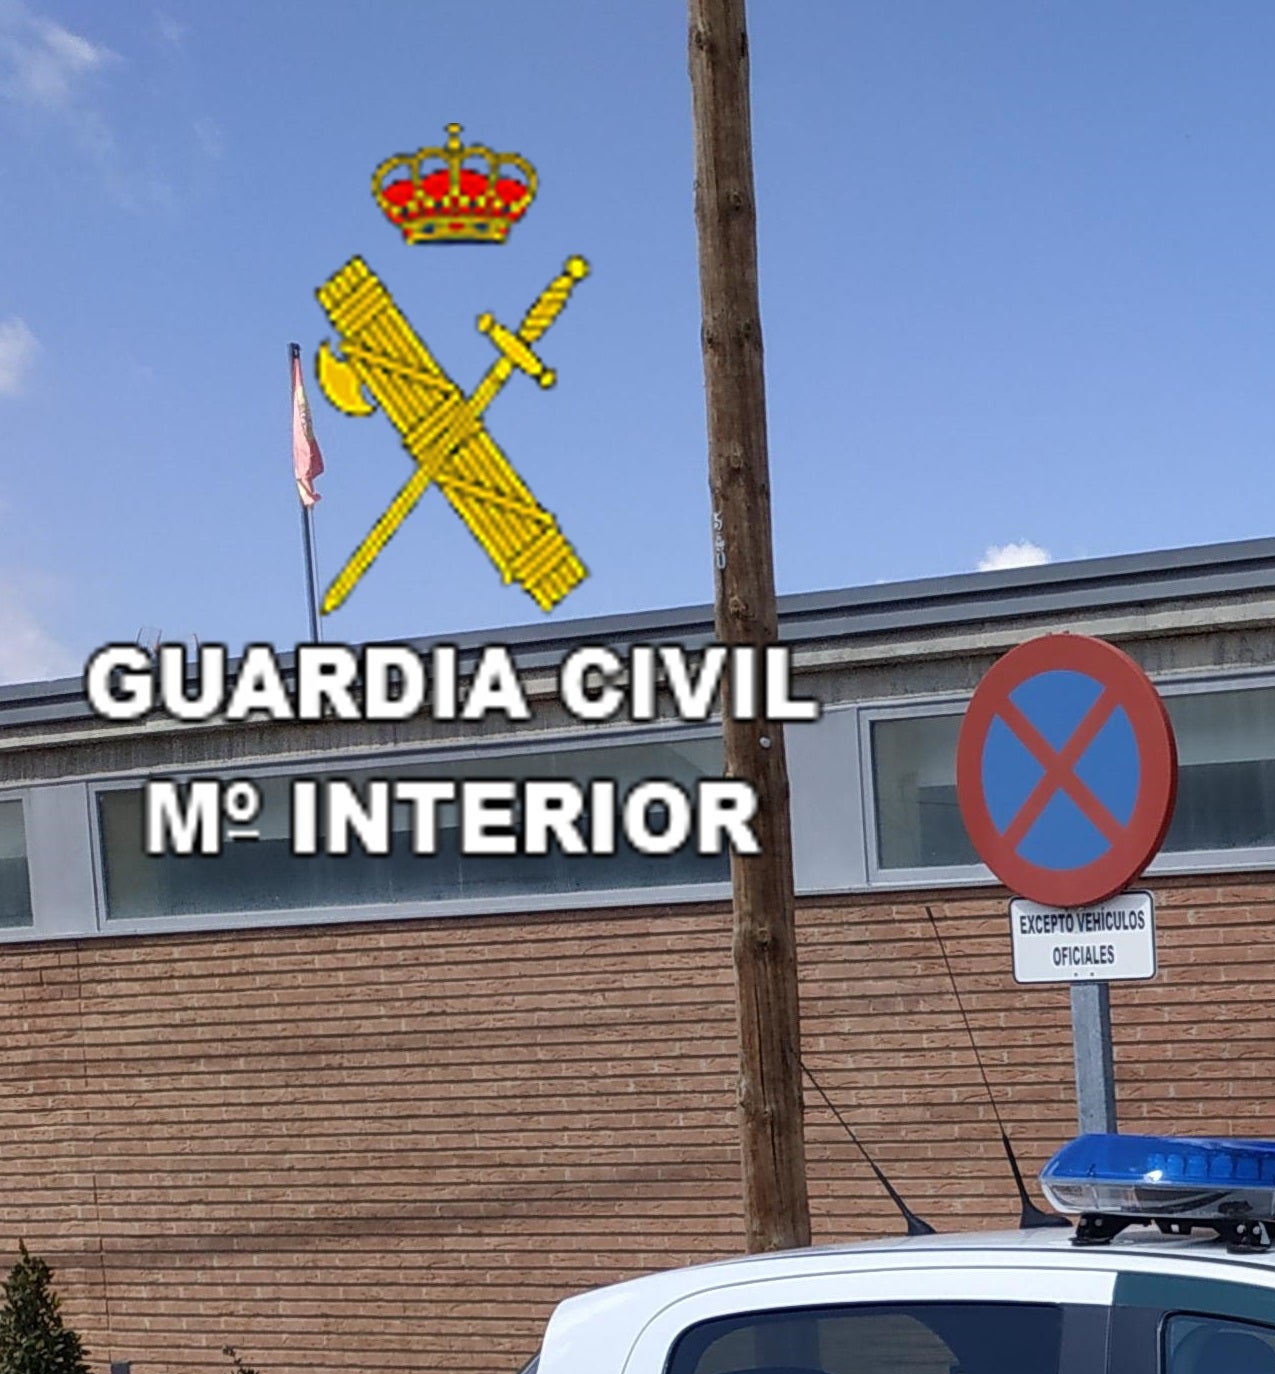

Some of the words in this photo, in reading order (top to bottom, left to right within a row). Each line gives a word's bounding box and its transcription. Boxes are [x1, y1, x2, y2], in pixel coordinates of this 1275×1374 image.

[1019, 913, 1075, 935] EXCEPTO
[1075, 907, 1146, 933] VEHÍCULOS
[1052, 945, 1115, 966] OFICIALES
